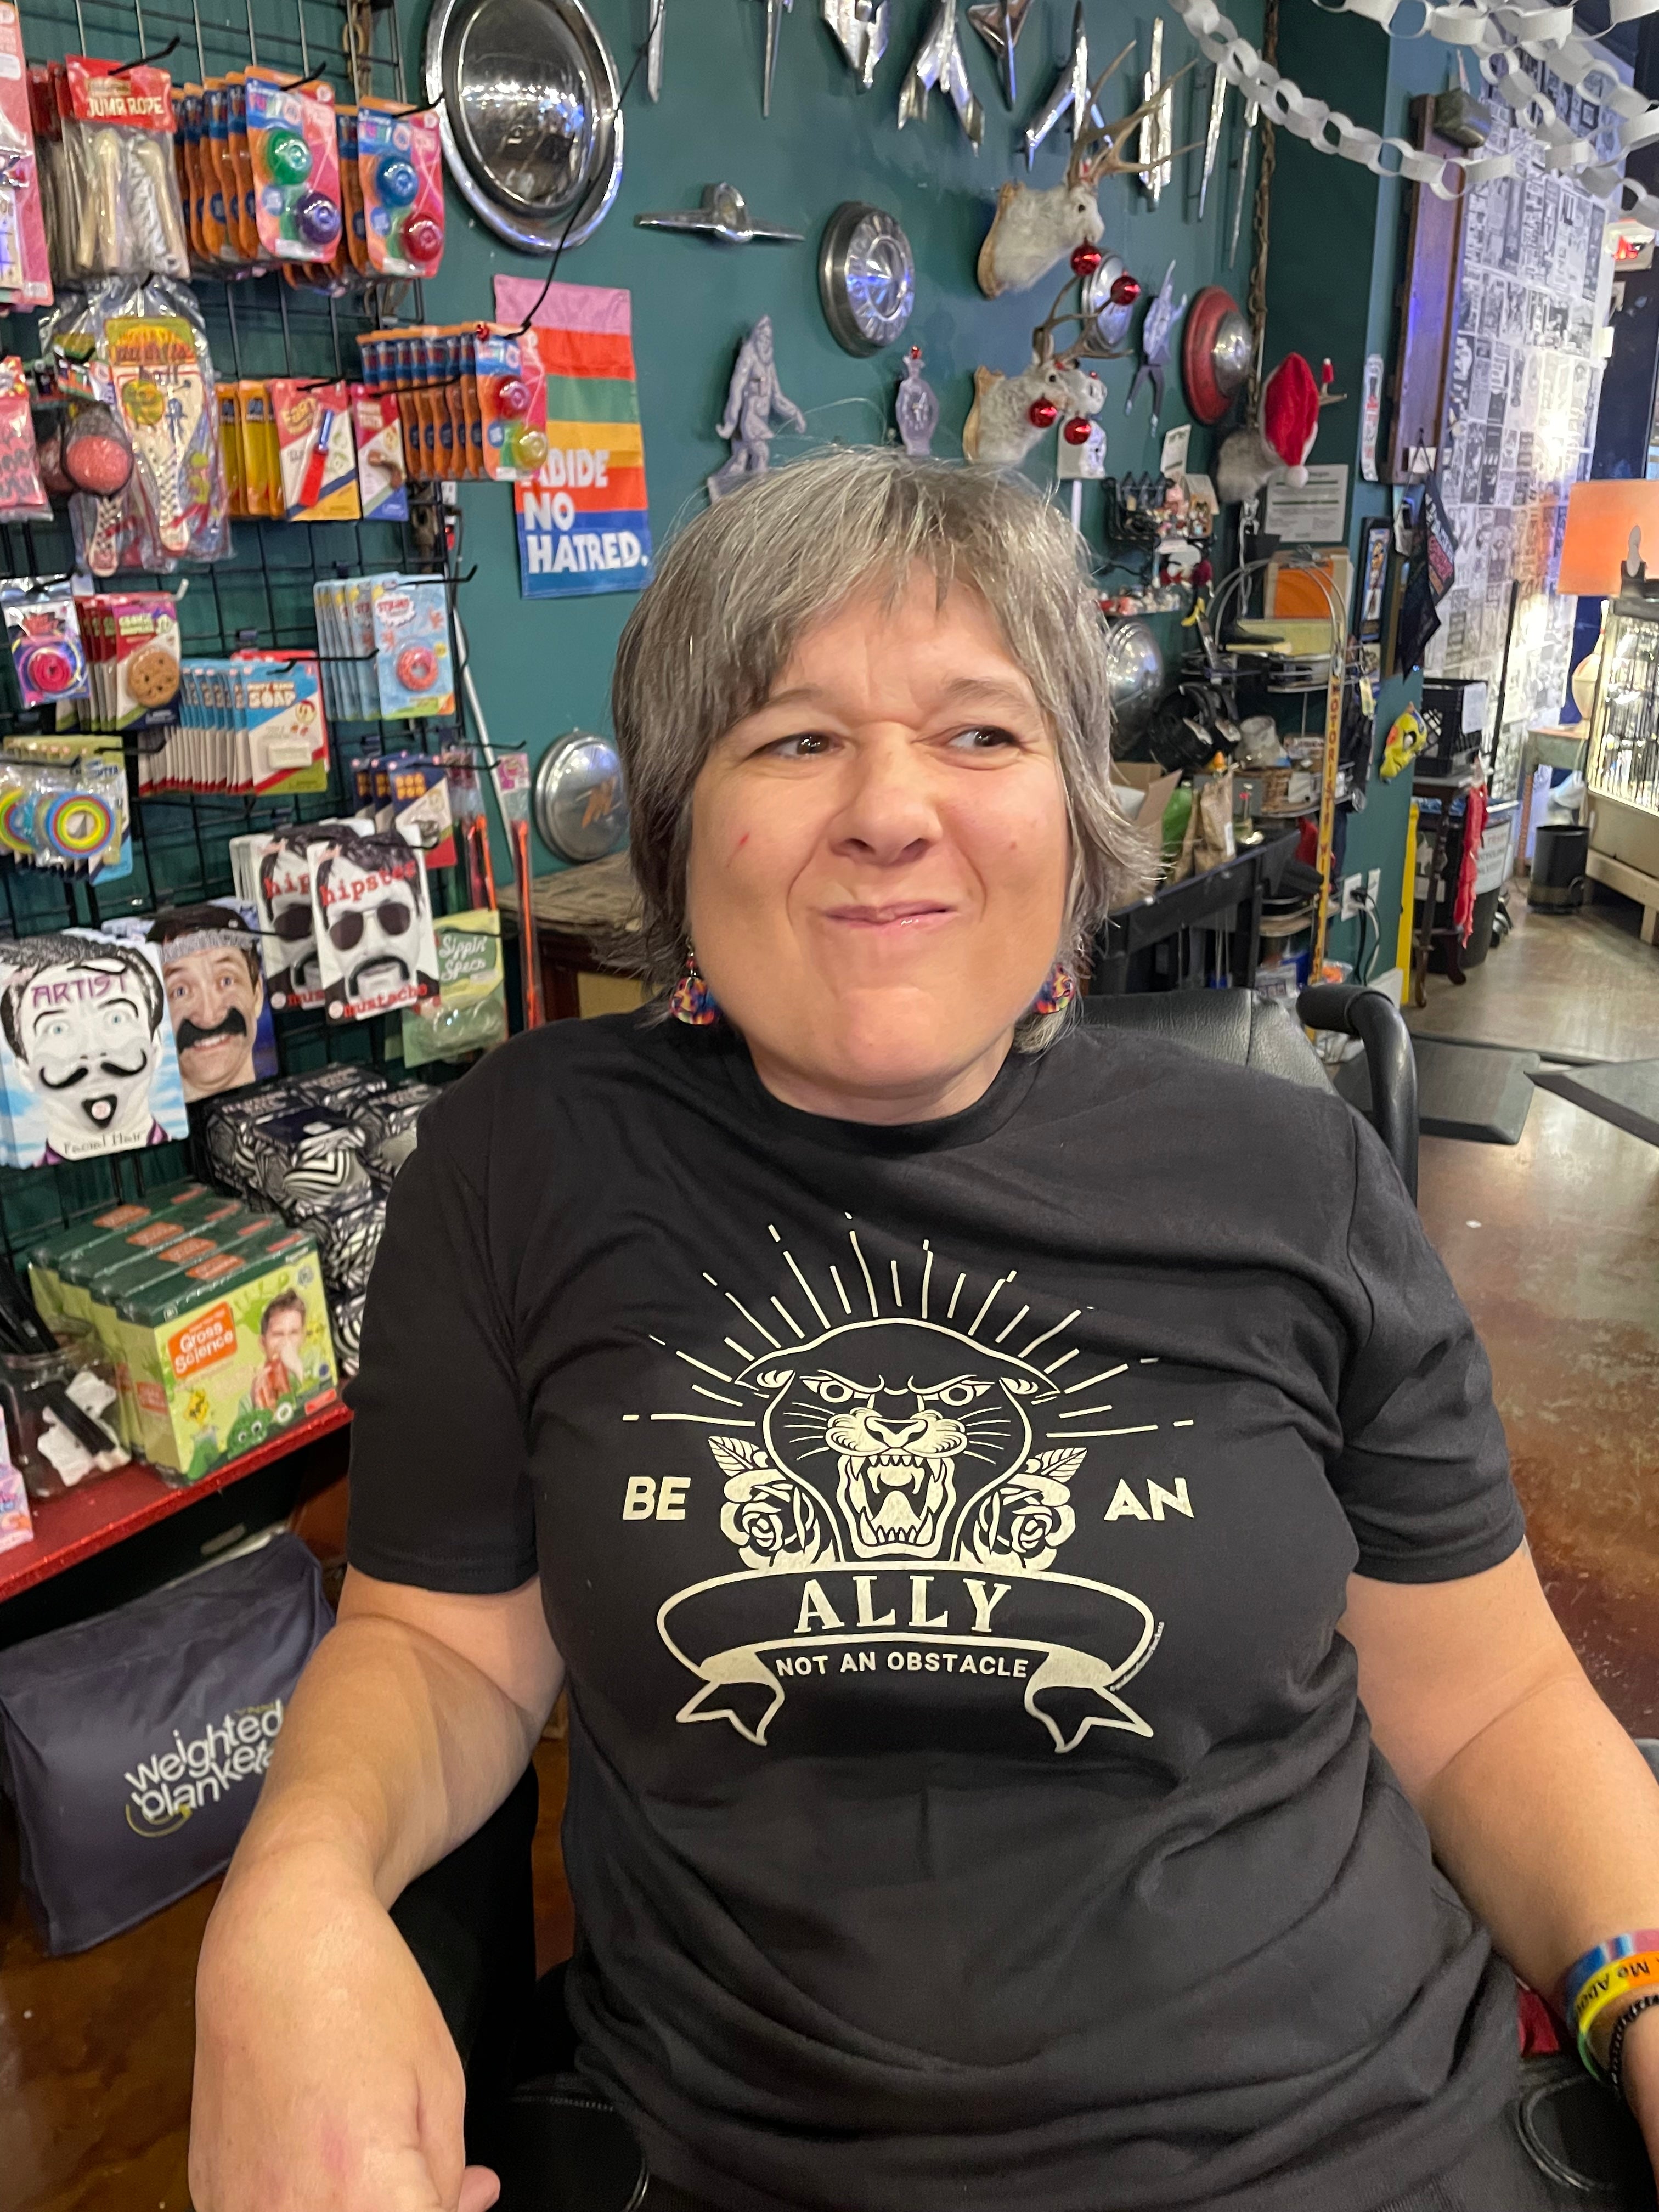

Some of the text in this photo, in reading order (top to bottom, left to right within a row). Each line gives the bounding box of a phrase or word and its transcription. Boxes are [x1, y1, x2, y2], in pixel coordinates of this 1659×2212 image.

[87, 95, 165, 119] JUMP ROPE
[523, 491, 575, 531] NO
[526, 531, 649, 574] HATRED.
[319, 860, 416, 907] hipster
[31, 973, 127, 1009] ARTIST
[343, 984, 428, 1018] mustache
[174, 1330, 234, 1375] Science
[180, 1322, 224, 1353] Gross
[623, 1476, 1194, 1521] BE AN
[793, 1575, 1012, 1633] ALLY
[775, 1651, 1029, 1678] NOT AN OBSTACLE
[124, 1698, 284, 1792] weighted
